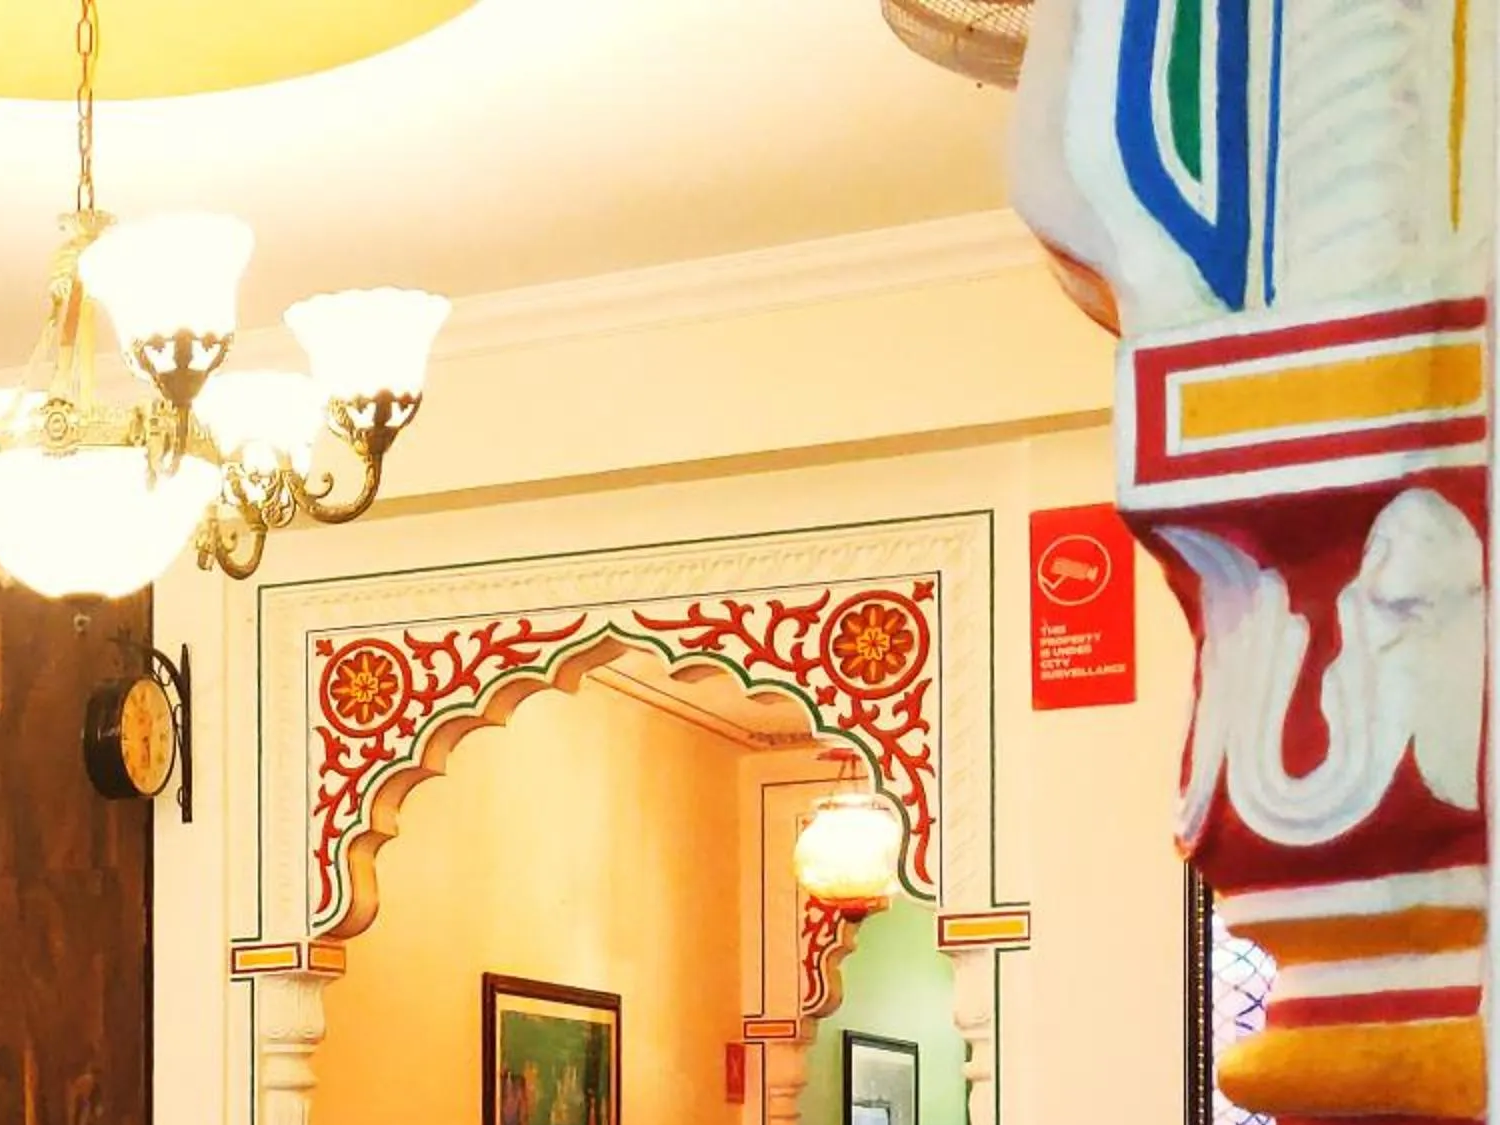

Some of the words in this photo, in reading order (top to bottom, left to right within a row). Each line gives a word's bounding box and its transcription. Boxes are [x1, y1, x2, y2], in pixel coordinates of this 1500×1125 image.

[1040, 624, 1067, 636] THIS
[1040, 632, 1101, 648] PROPERTY
[1053, 643, 1092, 656] UNDER
[1040, 663, 1126, 681] SURVEILLANCE
